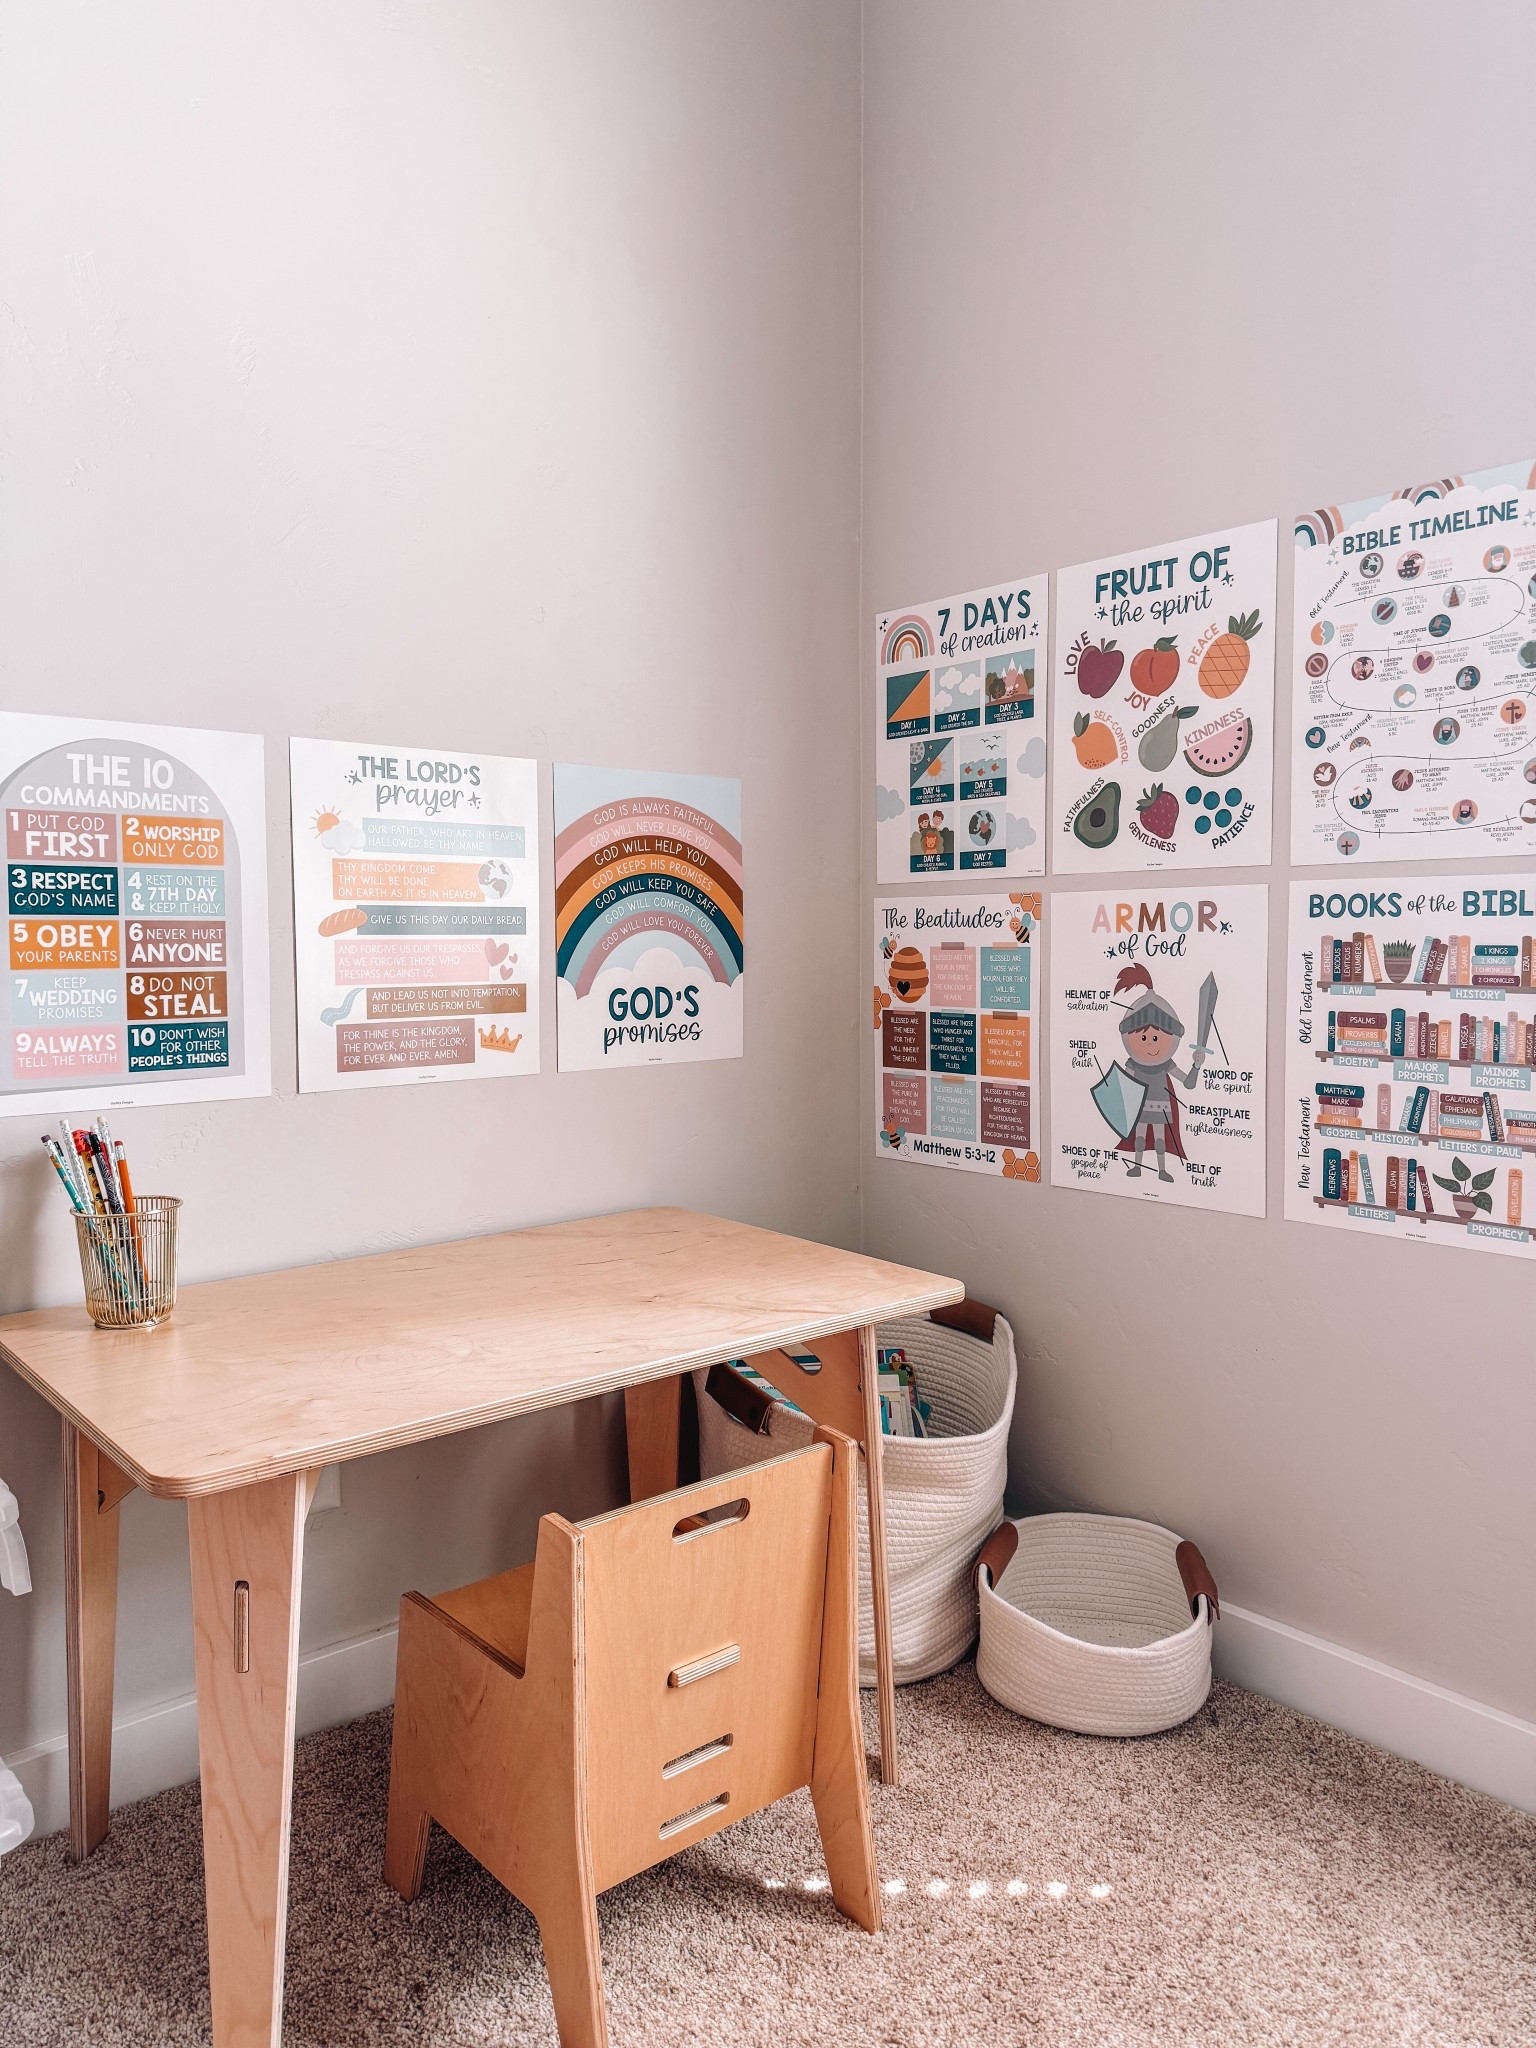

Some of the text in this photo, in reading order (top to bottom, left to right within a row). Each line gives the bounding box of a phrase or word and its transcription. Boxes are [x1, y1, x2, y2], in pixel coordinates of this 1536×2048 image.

[1342, 499, 1519, 555] BIBLE TIMELINE
[1094, 545, 1231, 604] FRUIT OF
[1309, 602, 1323, 619] Old
[1320, 569, 1350, 602] Testament
[937, 589, 1031, 637] 7 DAYS
[1111, 585, 1213, 627] the spirit
[940, 624, 1026, 658] of creation
[1187, 622, 1221, 666] PEACE
[1063, 630, 1092, 675] LOVE
[999, 702, 1019, 713] DAY 3
[1123, 691, 1152, 712] JOY
[947, 712, 966, 723] DAY 2
[1131, 695, 1176, 739] GOODNESS
[1092, 709, 1129, 766] SELF-CONTROL
[1183, 707, 1245, 748] KINDNESS
[1327, 742, 1340, 753] New
[1340, 713, 1373, 741] Testament
[66, 752, 174, 790] THE 10
[358, 755, 481, 786] THE LORD'S
[21, 785, 210, 813] COMMANDMENTS
[376, 784, 464, 816] prayer
[1063, 776, 1105, 833] FAITHFULNESS
[10, 811, 105, 831] 1 PUT GOD
[593, 802, 715, 836] GOD IS ALWAYS FAITHFUL
[1211, 802, 1255, 850] PATIENCE
[126, 817, 221, 842] 2 WORSHIP
[1128, 821, 1177, 853] GENTLENESS
[25, 830, 110, 858] FIRST
[132, 841, 219, 859] ONLY GOD
[594, 838, 708, 867] GOD WILL HELP YOU
[11, 868, 115, 891] 3 RESPECT
[127, 871, 217, 890] 4 REST ON THE
[14, 892, 116, 908] GOD'S NAME
[130, 887, 217, 911] & 7TH DAY
[149, 902, 221, 914] KEEP IT HOLY
[1309, 892, 1402, 918] BOOKS
[1407, 894, 1426, 915] of
[1429, 894, 1457, 912] the
[370, 914, 392, 924] GIVE
[395, 915, 407, 924] US
[409, 915, 430, 924] THIS
[432, 915, 449, 925] DAY
[451, 915, 469, 925] OUR
[471, 915, 493, 925] DAILY
[881, 906, 1005, 930] The Beatitudes
[1091, 900, 1219, 934] ARMOR
[13, 922, 114, 948] 5 OBEY
[129, 923, 223, 942] 6 NEVER HURT
[131, 942, 223, 963] ANYONE
[1118, 933, 1187, 960] of God
[16, 951, 117, 963] YOUR PARENTS
[130, 975, 215, 995] 8 DO NOT
[1064, 989, 1111, 1001] HELMET OF
[1342, 986, 1363, 995] LAW
[1455, 989, 1500, 999] HISTORY
[143, 994, 221, 1017] STEAL
[608, 985, 700, 1021] GOD'S
[1066, 1000, 1109, 1012] salvation
[1299, 950, 1314, 1044] Old Testament
[1350, 1016, 1376, 1025] PSALMS
[131, 1027, 225, 1047] 10 DON'T WISH
[343, 1031, 360, 1040] FOR
[363, 1029, 389, 1039] THINE
[391, 1029, 399, 1038] IS
[402, 1027, 418, 1037] THE
[603, 1021, 703, 1055] promises
[160, 1040, 221, 1053] FOR OTHER
[1068, 1039, 1097, 1050] SHIELD
[1077, 1049, 1088, 1058] OF
[131, 1052, 227, 1068] PEOPLE'S THINGS
[1071, 1056, 1094, 1069] faith
[1339, 1057, 1374, 1067] POETRY
[1404, 1062, 1438, 1072] MAJOR
[1202, 1069, 1254, 1082] SWORD OF
[1398, 1071, 1445, 1082] PROPHETS
[1475, 1076, 1526, 1089] PROPHETS
[1482, 1067, 1520, 1078] MINOR
[1203, 1080, 1253, 1095] the spirit
[1323, 1087, 1356, 1096] MATTHEW
[1189, 1105, 1251, 1120] BREASTPLATE
[1213, 1117, 1225, 1127] OF
[1185, 1122, 1253, 1139] righteousness
[1326, 1128, 1361, 1139] GOSPEL
[1374, 1133, 1416, 1145] HISTORY
[913, 1139, 996, 1164] Matthew 5:3-12
[1298, 1096, 1311, 1189] New Testament
[1440, 1140, 1521, 1158] LETTERS OF PAUL
[1061, 1145, 1119, 1161] SHOES OF THE
[1070, 1158, 1109, 1171] gospel of
[1186, 1162, 1222, 1176] BELT OF
[1077, 1170, 1101, 1180] peace
[1191, 1174, 1217, 1188] truth
[1328, 1159, 1336, 1195] HEBREWS
[1354, 1208, 1389, 1220] LETTERS
[1472, 1225, 1524, 1240] PROPHECY
